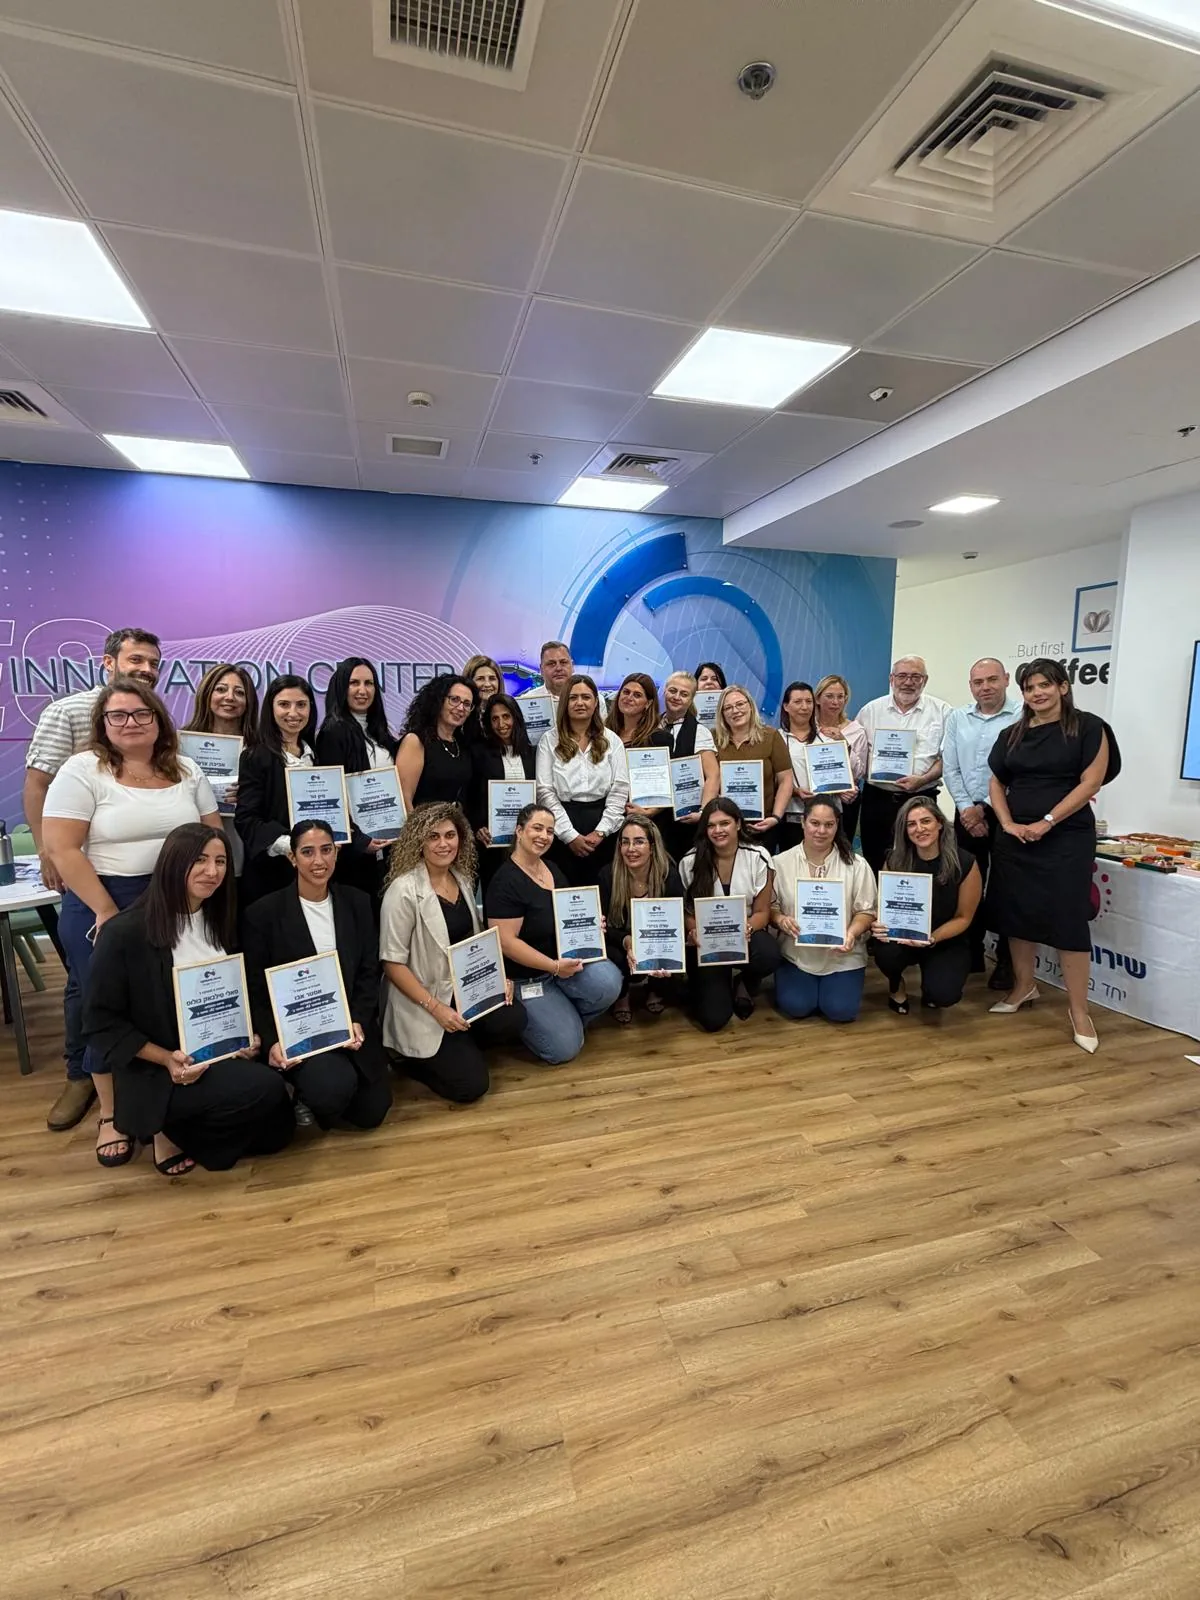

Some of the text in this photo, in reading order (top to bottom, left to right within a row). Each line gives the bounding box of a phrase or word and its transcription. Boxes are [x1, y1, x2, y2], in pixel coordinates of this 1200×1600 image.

[1040, 641, 1065, 656] first
[1091, 944, 1147, 979] שירו
[1101, 982, 1127, 1001] יחד
